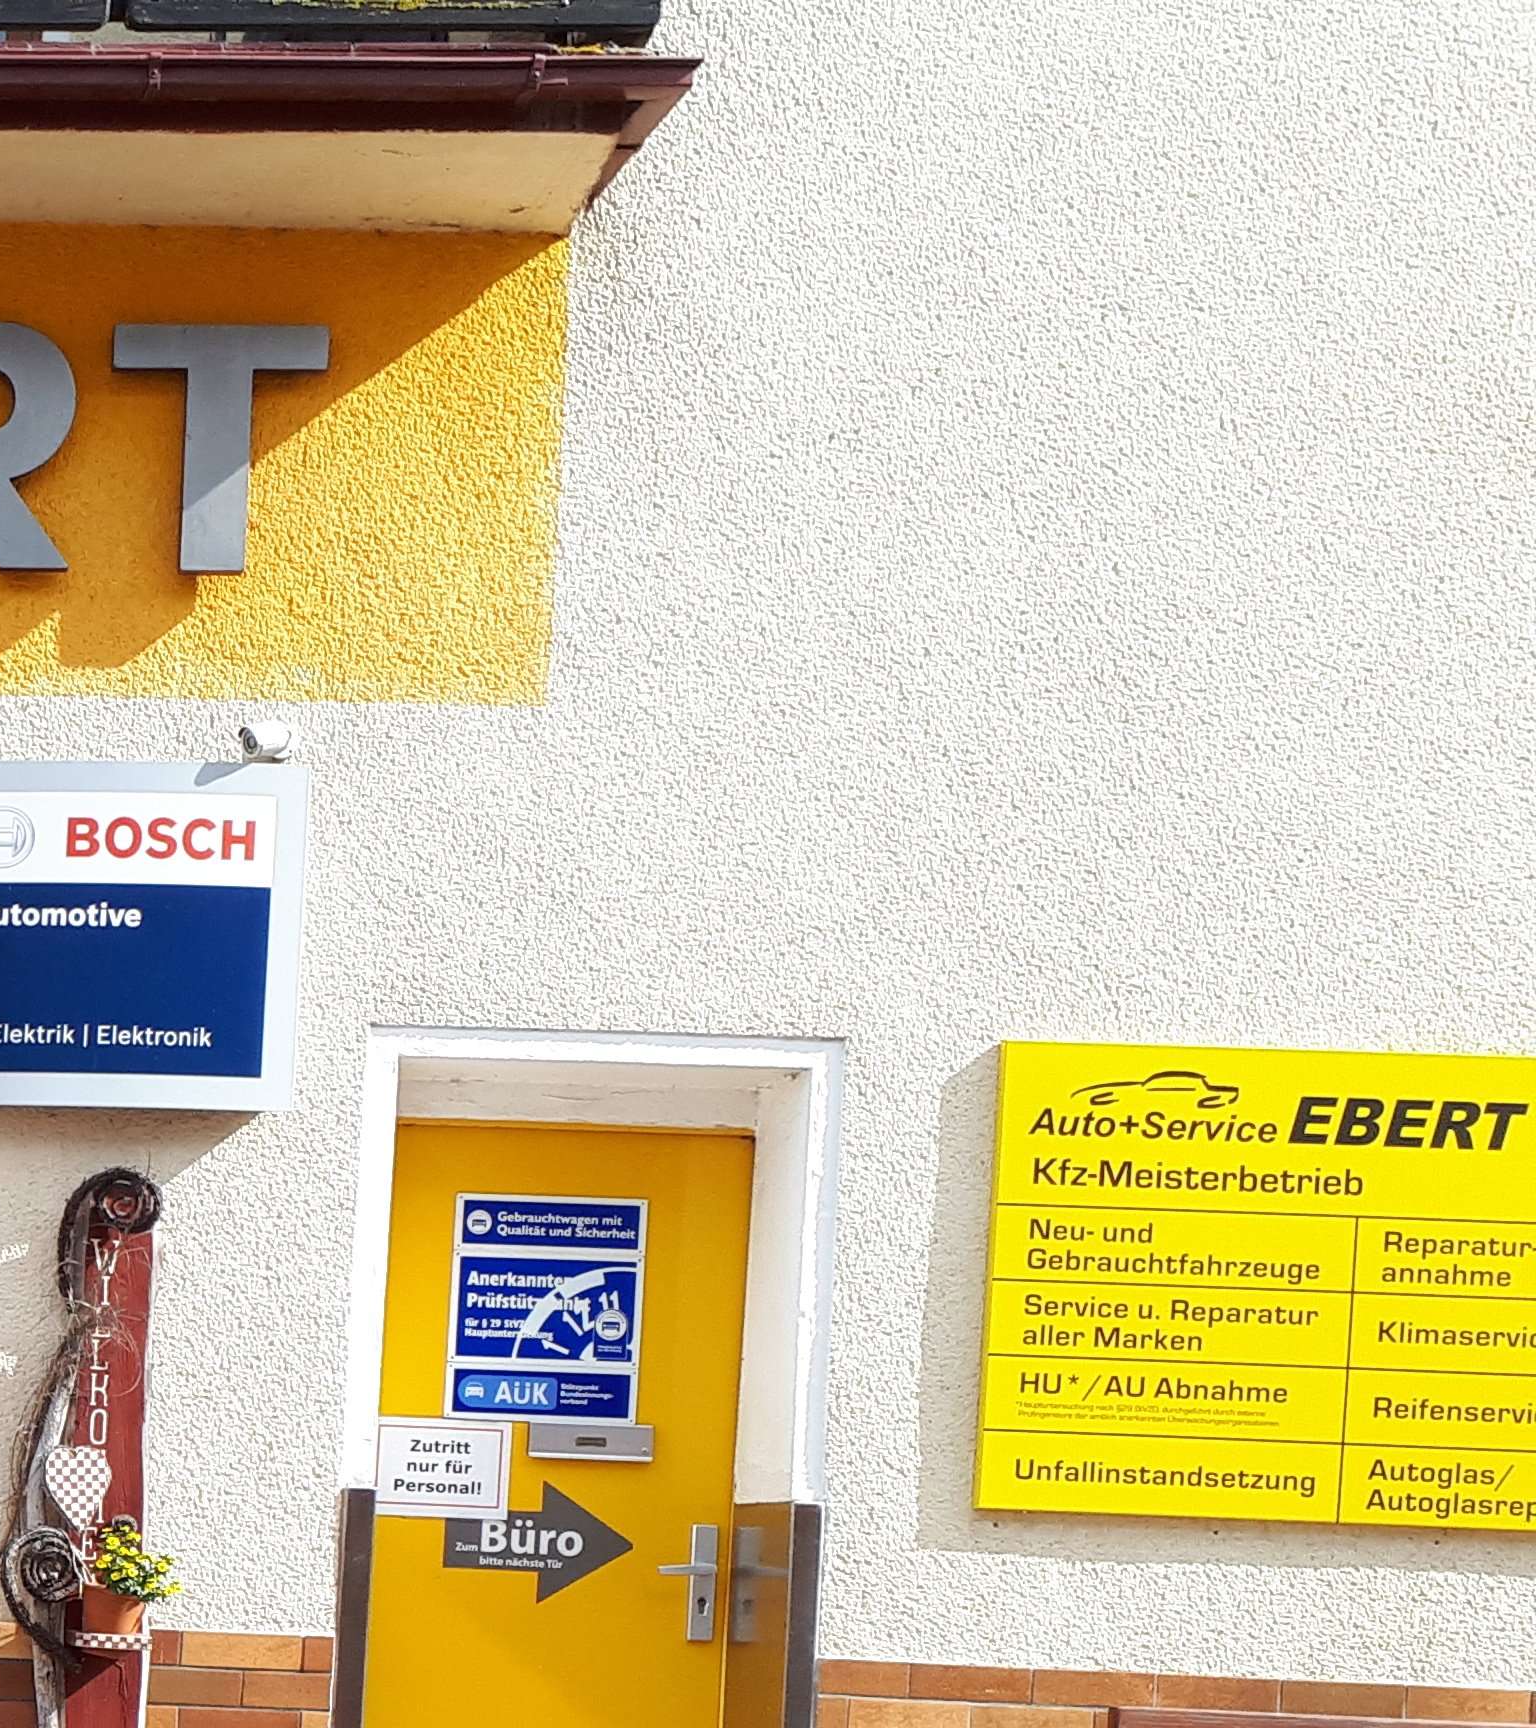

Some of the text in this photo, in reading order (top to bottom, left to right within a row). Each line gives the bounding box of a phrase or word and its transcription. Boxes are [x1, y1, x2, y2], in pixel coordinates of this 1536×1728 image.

[65, 816, 257, 861] BOSCH
[96, 1024, 213, 1048] Elektronik
[1029, 1096, 1528, 1151] Auto+Service EBERT
[1032, 1158, 1365, 1197] Kfz-Meisterbetrieb
[496, 1224, 636, 1240] Qualität und Sicherheit
[497, 1211, 623, 1226] Gebrauchtwagen mit
[1029, 1217, 1154, 1245] Neu- und
[1026, 1248, 1321, 1285] Gebrauchtfahrzeuge
[1381, 1264, 1512, 1287] annahme
[1024, 1293, 1320, 1330] Service u. Reparatur
[1022, 1324, 1204, 1352] aller Marken
[493, 1381, 549, 1405] AÜK
[1154, 1375, 1289, 1405] Abnahme
[1373, 1397, 1536, 1424] Reifenservi
[410, 1438, 472, 1456] Zutritt
[406, 1457, 474, 1476] nur für
[1014, 1458, 1317, 1498] Unfallinstandsetzung
[1367, 1459, 1515, 1492] Autoglas/
[393, 1478, 483, 1497] Personal!
[455, 1519, 585, 1557] Zum Büro
[479, 1555, 565, 1569] bitte nächste Tür
